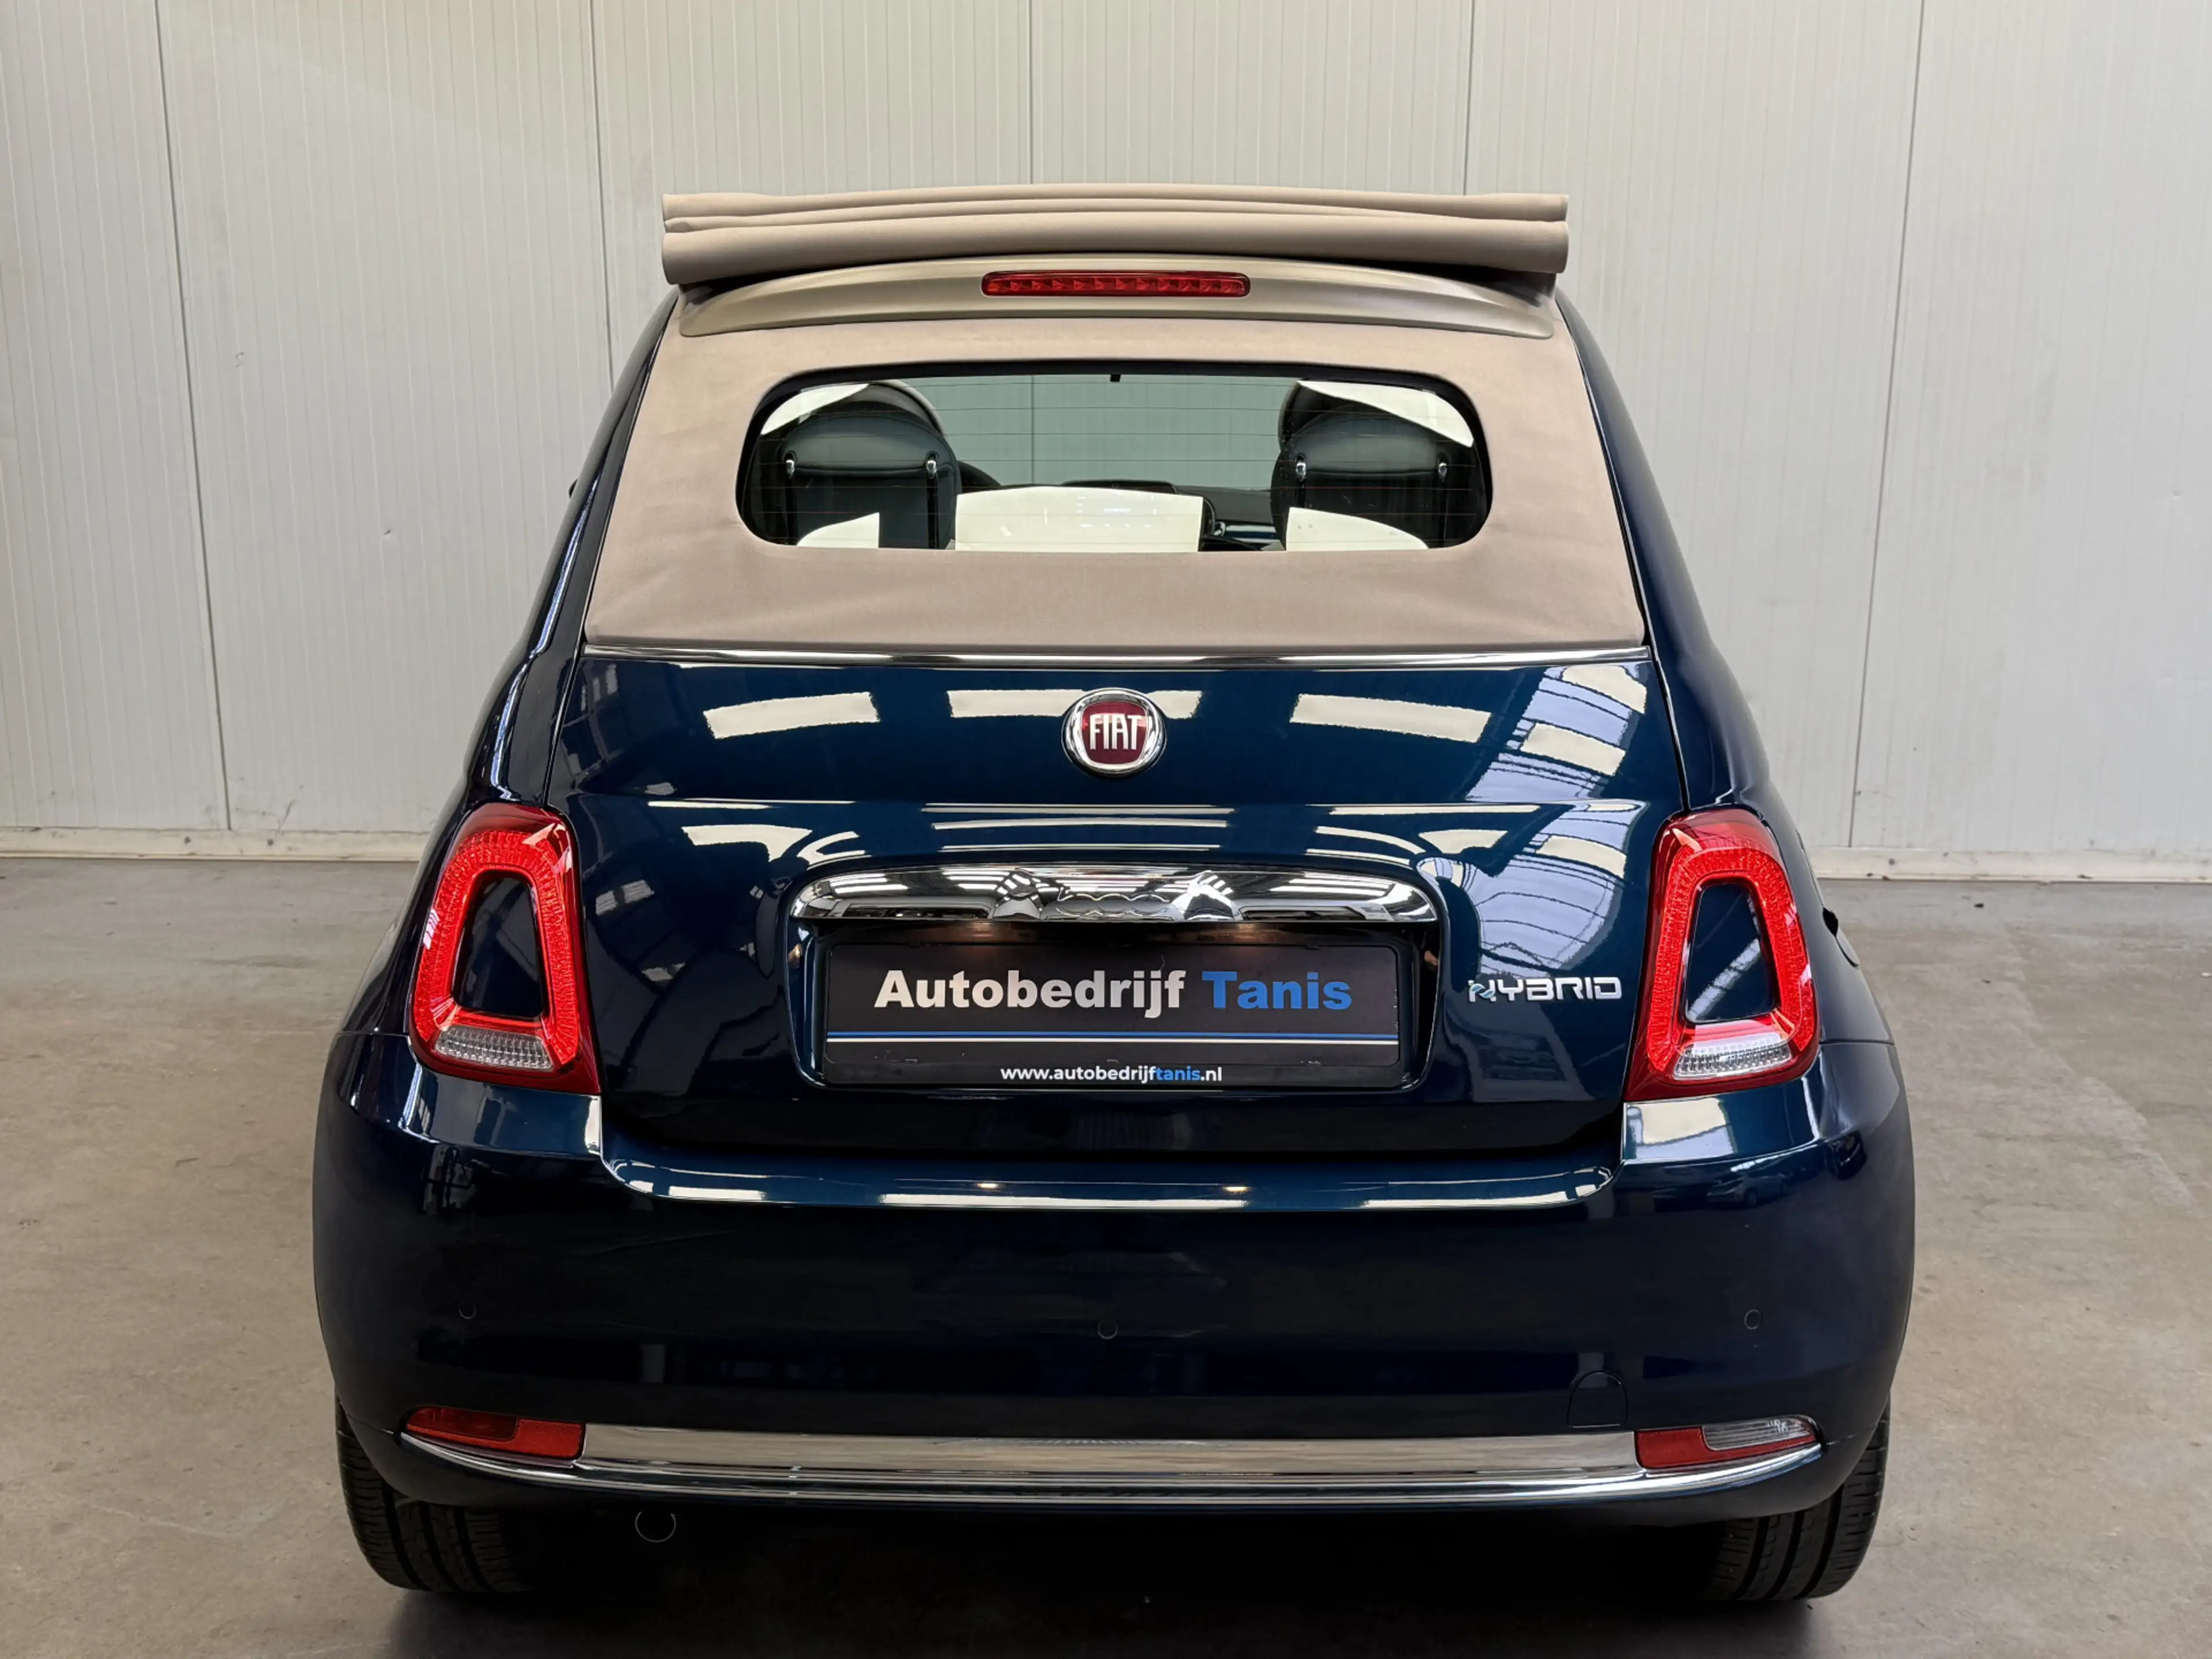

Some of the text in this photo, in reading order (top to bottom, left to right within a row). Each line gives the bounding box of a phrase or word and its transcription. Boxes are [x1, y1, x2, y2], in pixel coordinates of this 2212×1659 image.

[1089, 714, 1142, 750] FIAT
[874, 970, 1353, 1019] Autobedrijf Tanis
[1468, 977, 1623, 1003] HYBRID
[1001, 1066, 1223, 1085] www.autobedrijftanis.nl
